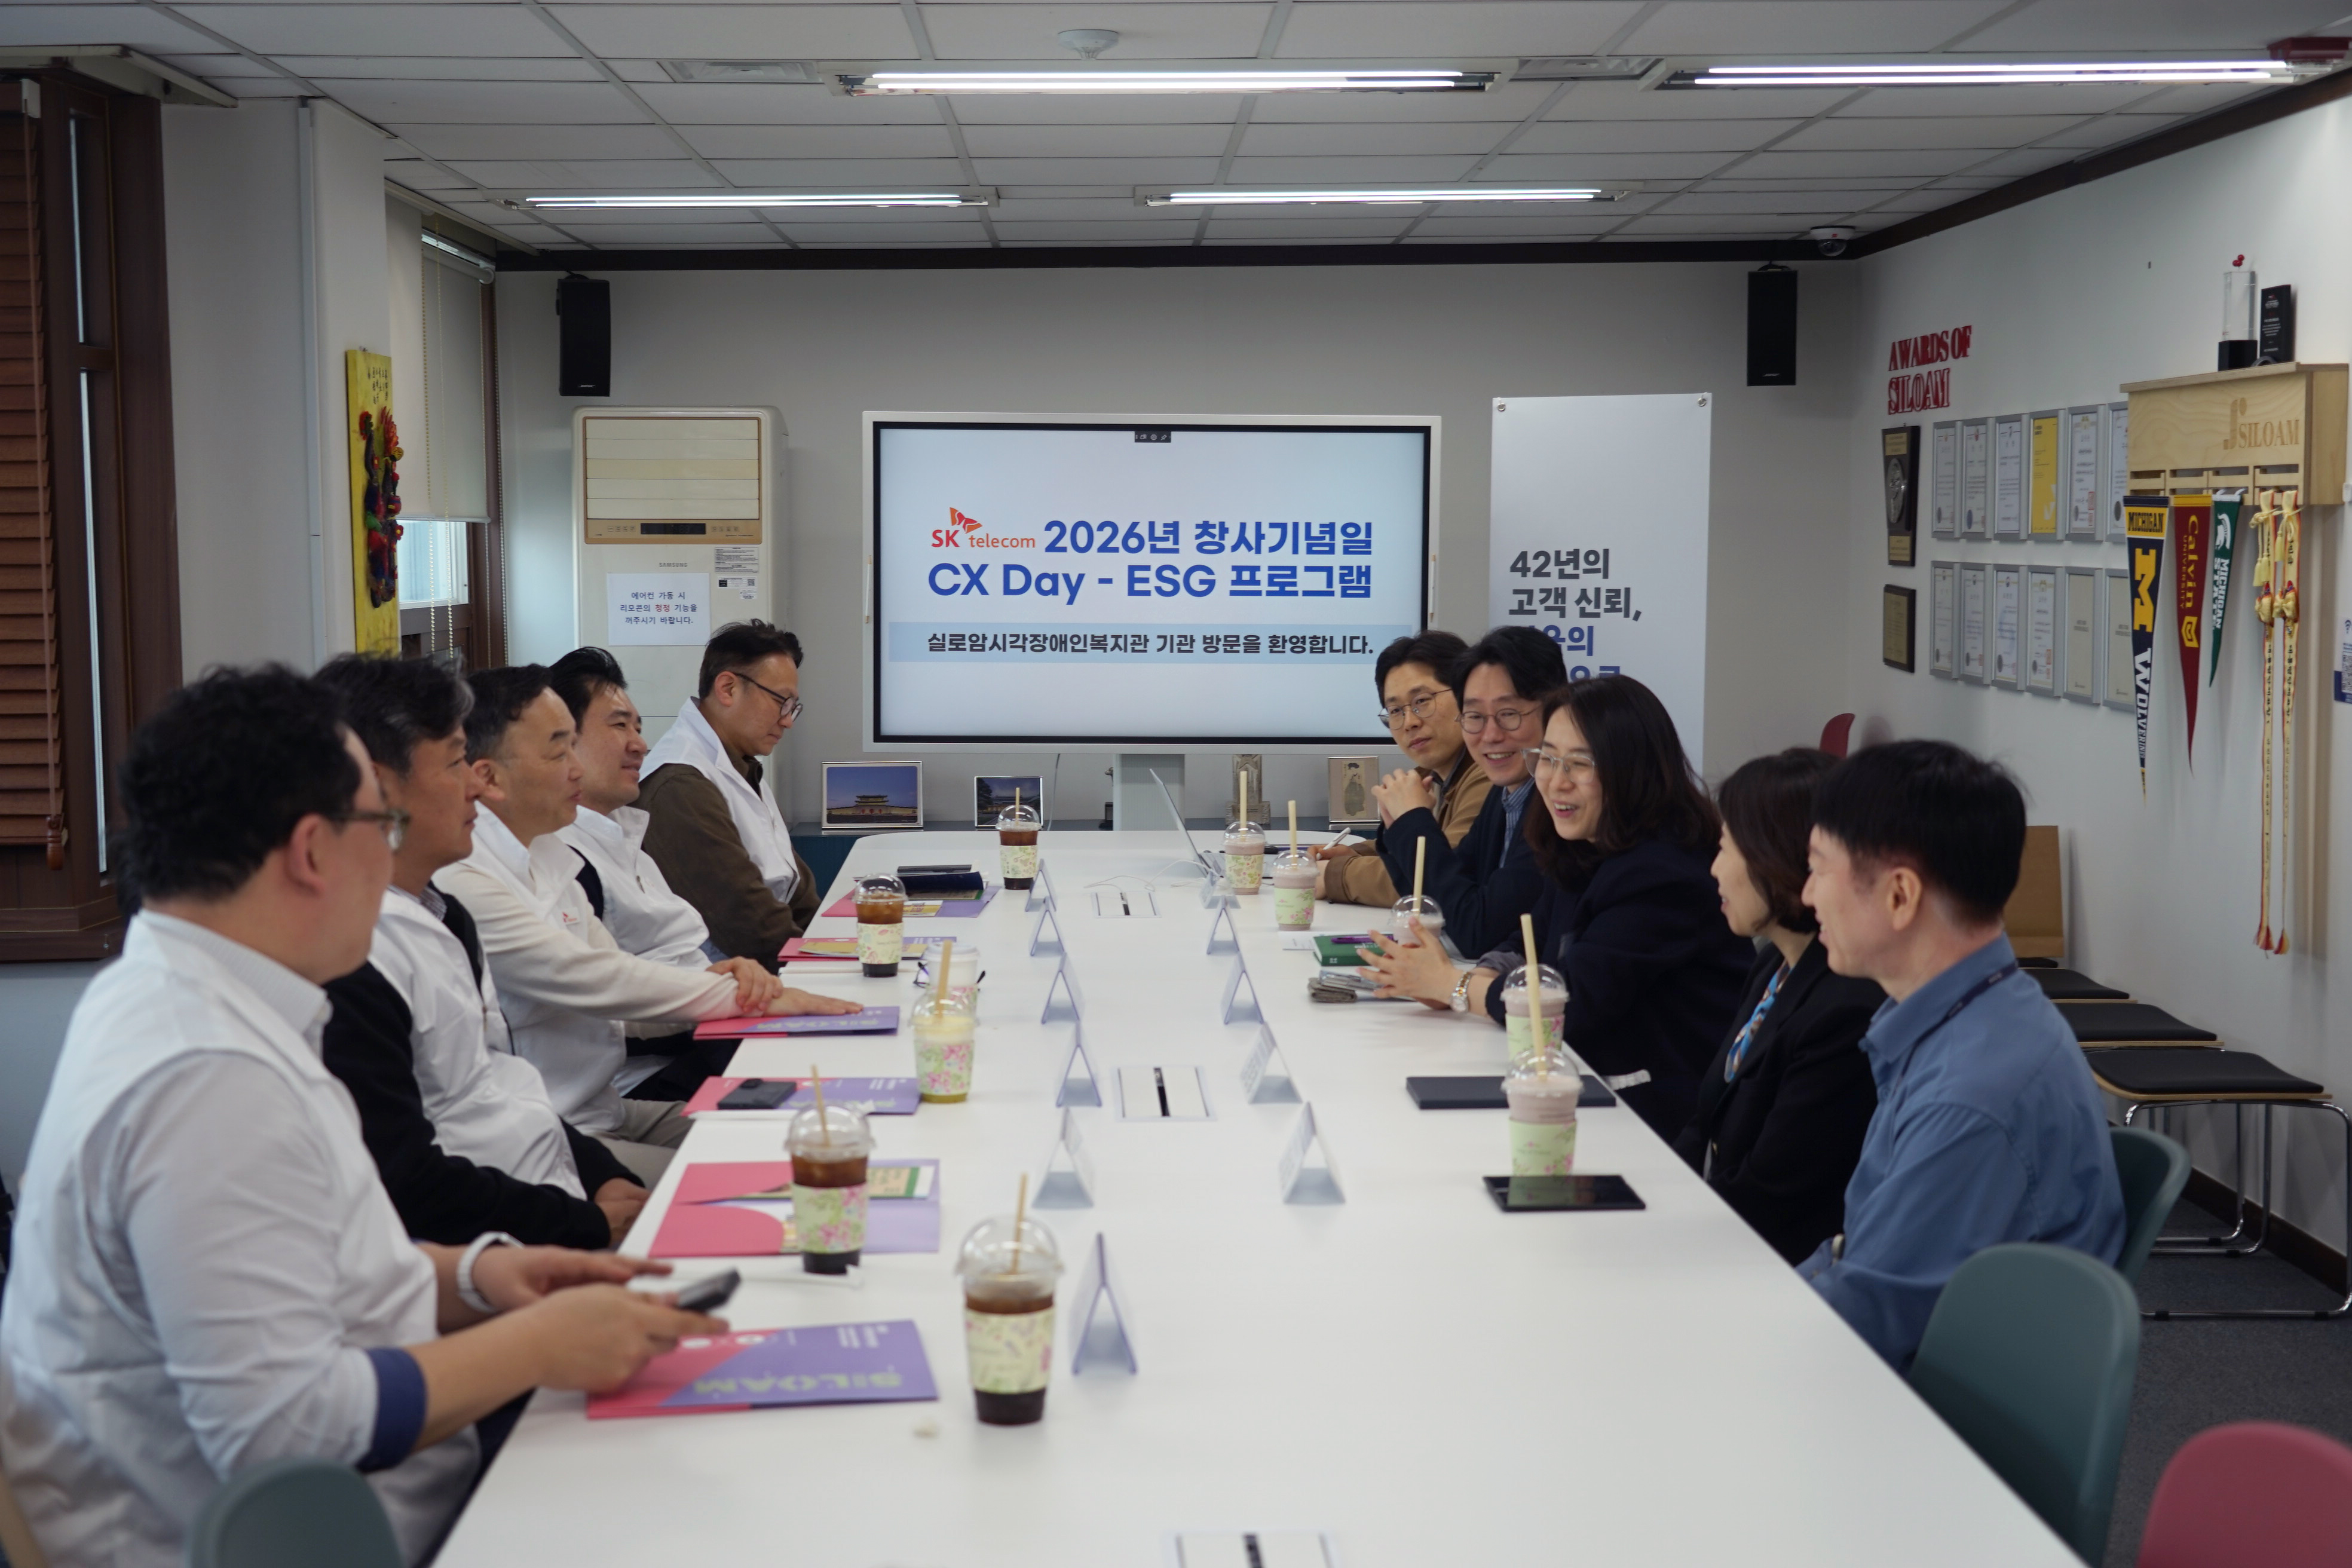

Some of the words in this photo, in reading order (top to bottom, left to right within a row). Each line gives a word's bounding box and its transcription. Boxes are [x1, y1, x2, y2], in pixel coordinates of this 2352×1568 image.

[1888, 330, 1949, 371] AWARDS
[1951, 325, 1972, 359] OF
[1888, 368, 1950, 415] SILOAM
[2238, 419, 2300, 449] SILOAM
[1045, 520, 1180, 555] 2026년
[1194, 520, 1373, 556] 창사기념일
[2128, 512, 2164, 533] MICHIGAN
[931, 529, 960, 549] SK
[968, 533, 1036, 549] telecom
[1509, 548, 1610, 580] 42년의
[2185, 514, 2199, 608] Calvin
[631, 592, 654, 600] 에어컨
[659, 592, 674, 600] 가동
[678, 592, 685, 600] 시
[928, 563, 989, 596] CX
[1003, 564, 1086, 605] Day
[1127, 564, 1216, 598] ESG
[1229, 565, 1371, 598] 프로그램
[2216, 558, 2230, 629] MICHIGAN
[620, 604, 651, 612] 리모콘의
[655, 604, 670, 612] 청정
[674, 604, 697, 612] 기능을
[1508, 586, 1567, 618] 고객
[1575, 586, 1642, 621] 신뢰,
[927, 632, 1150, 654] 실로암시각장애인복지관
[1157, 634, 1196, 654] 기관
[1202, 634, 1261, 654] 방문을
[1268, 634, 1374, 655] 환영합니다.
[693, 1371, 903, 1396] SILOAM
